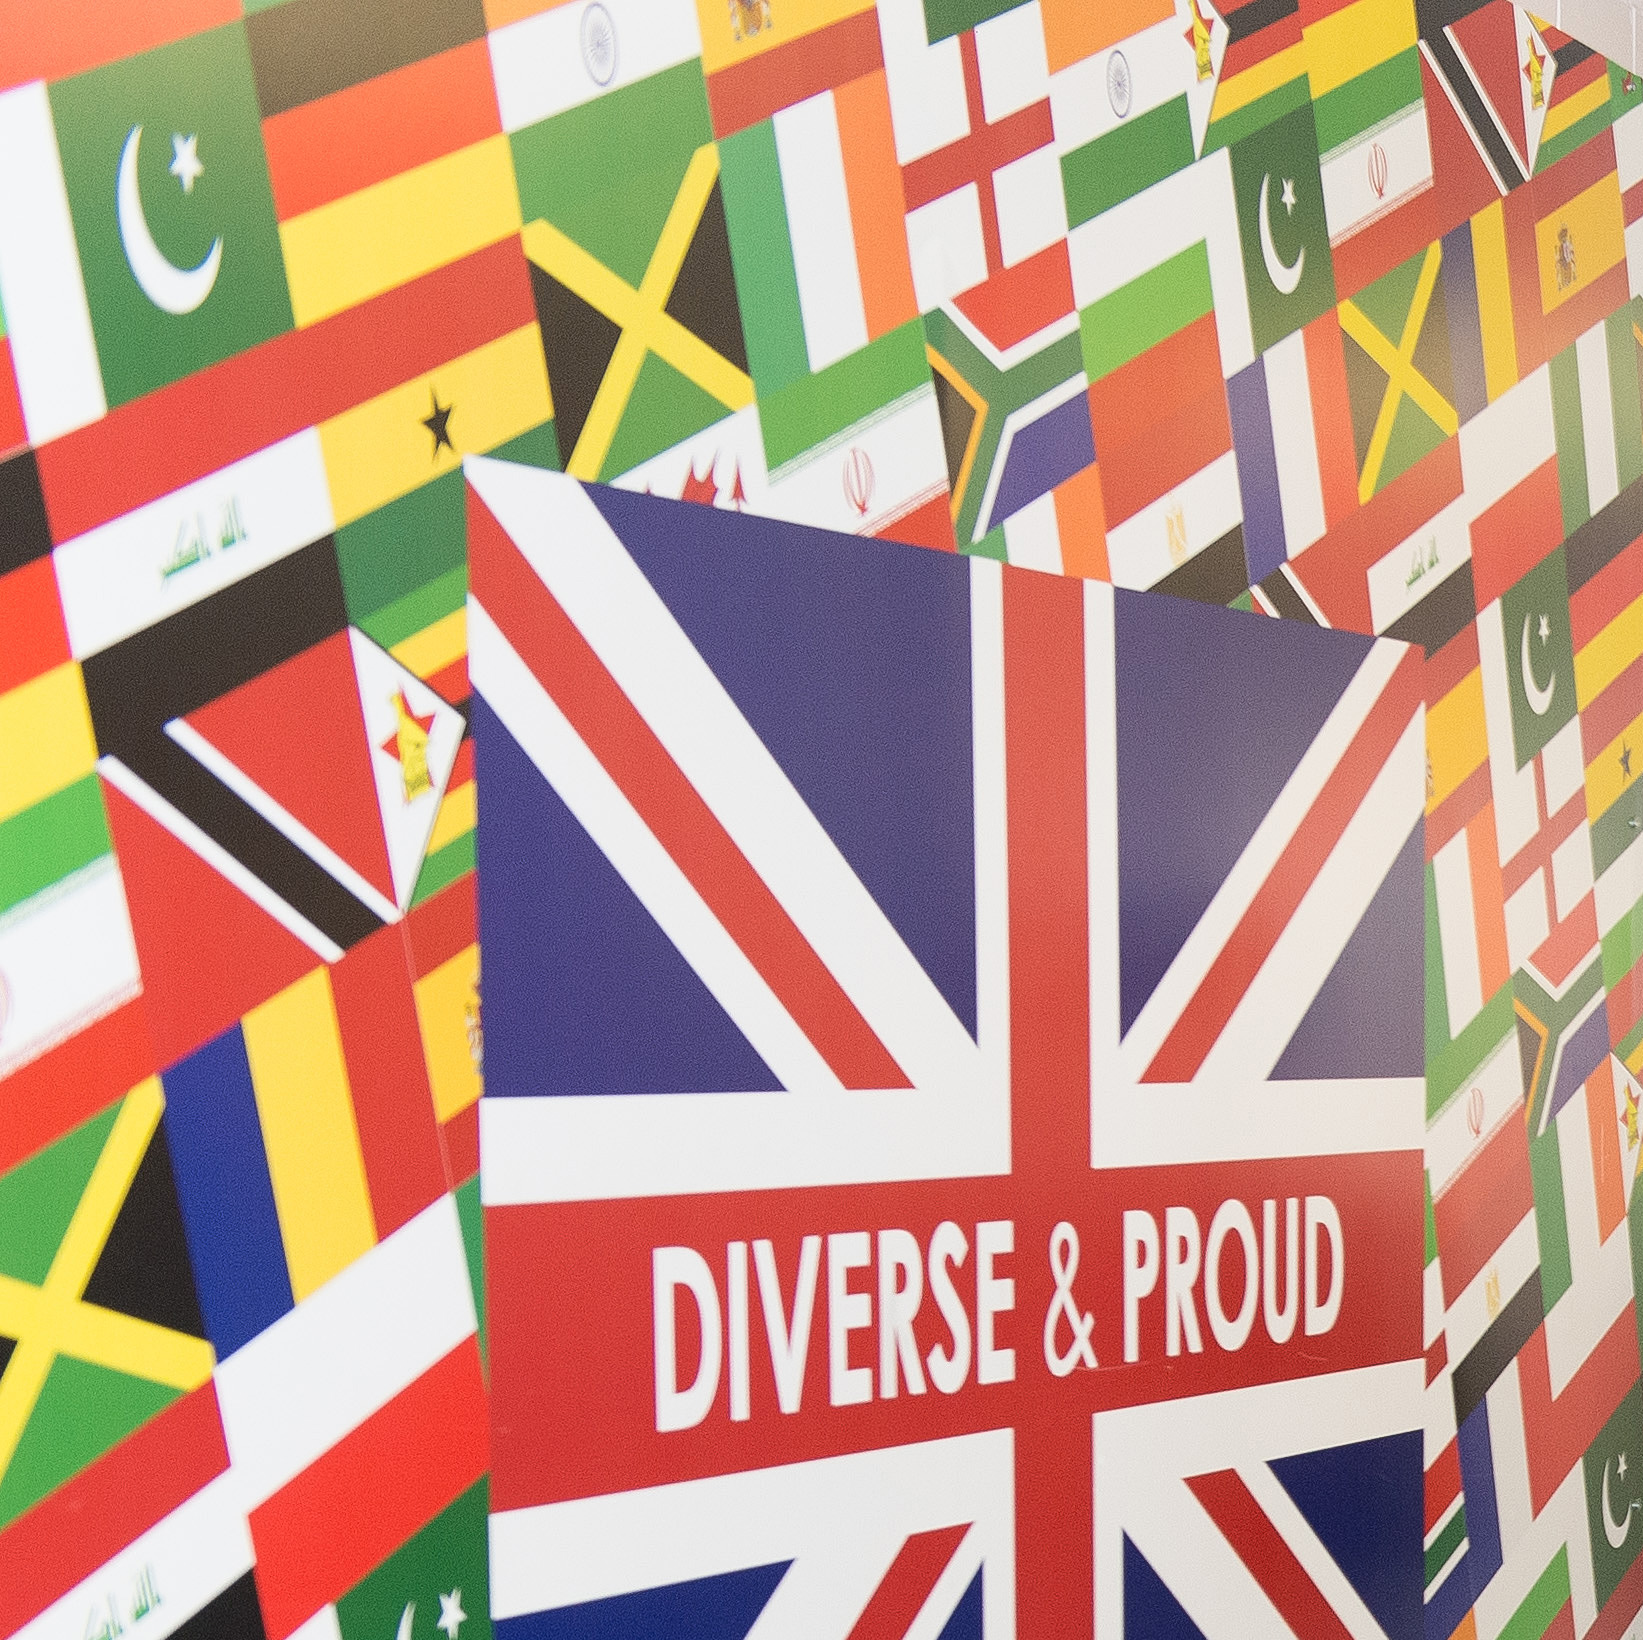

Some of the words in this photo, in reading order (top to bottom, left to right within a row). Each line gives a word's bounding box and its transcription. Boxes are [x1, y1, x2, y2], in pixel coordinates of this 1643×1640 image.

[652, 1220, 1016, 1433] DIVERSE
[1043, 1221, 1099, 1378] &
[1122, 1195, 1345, 1363] PROUD
